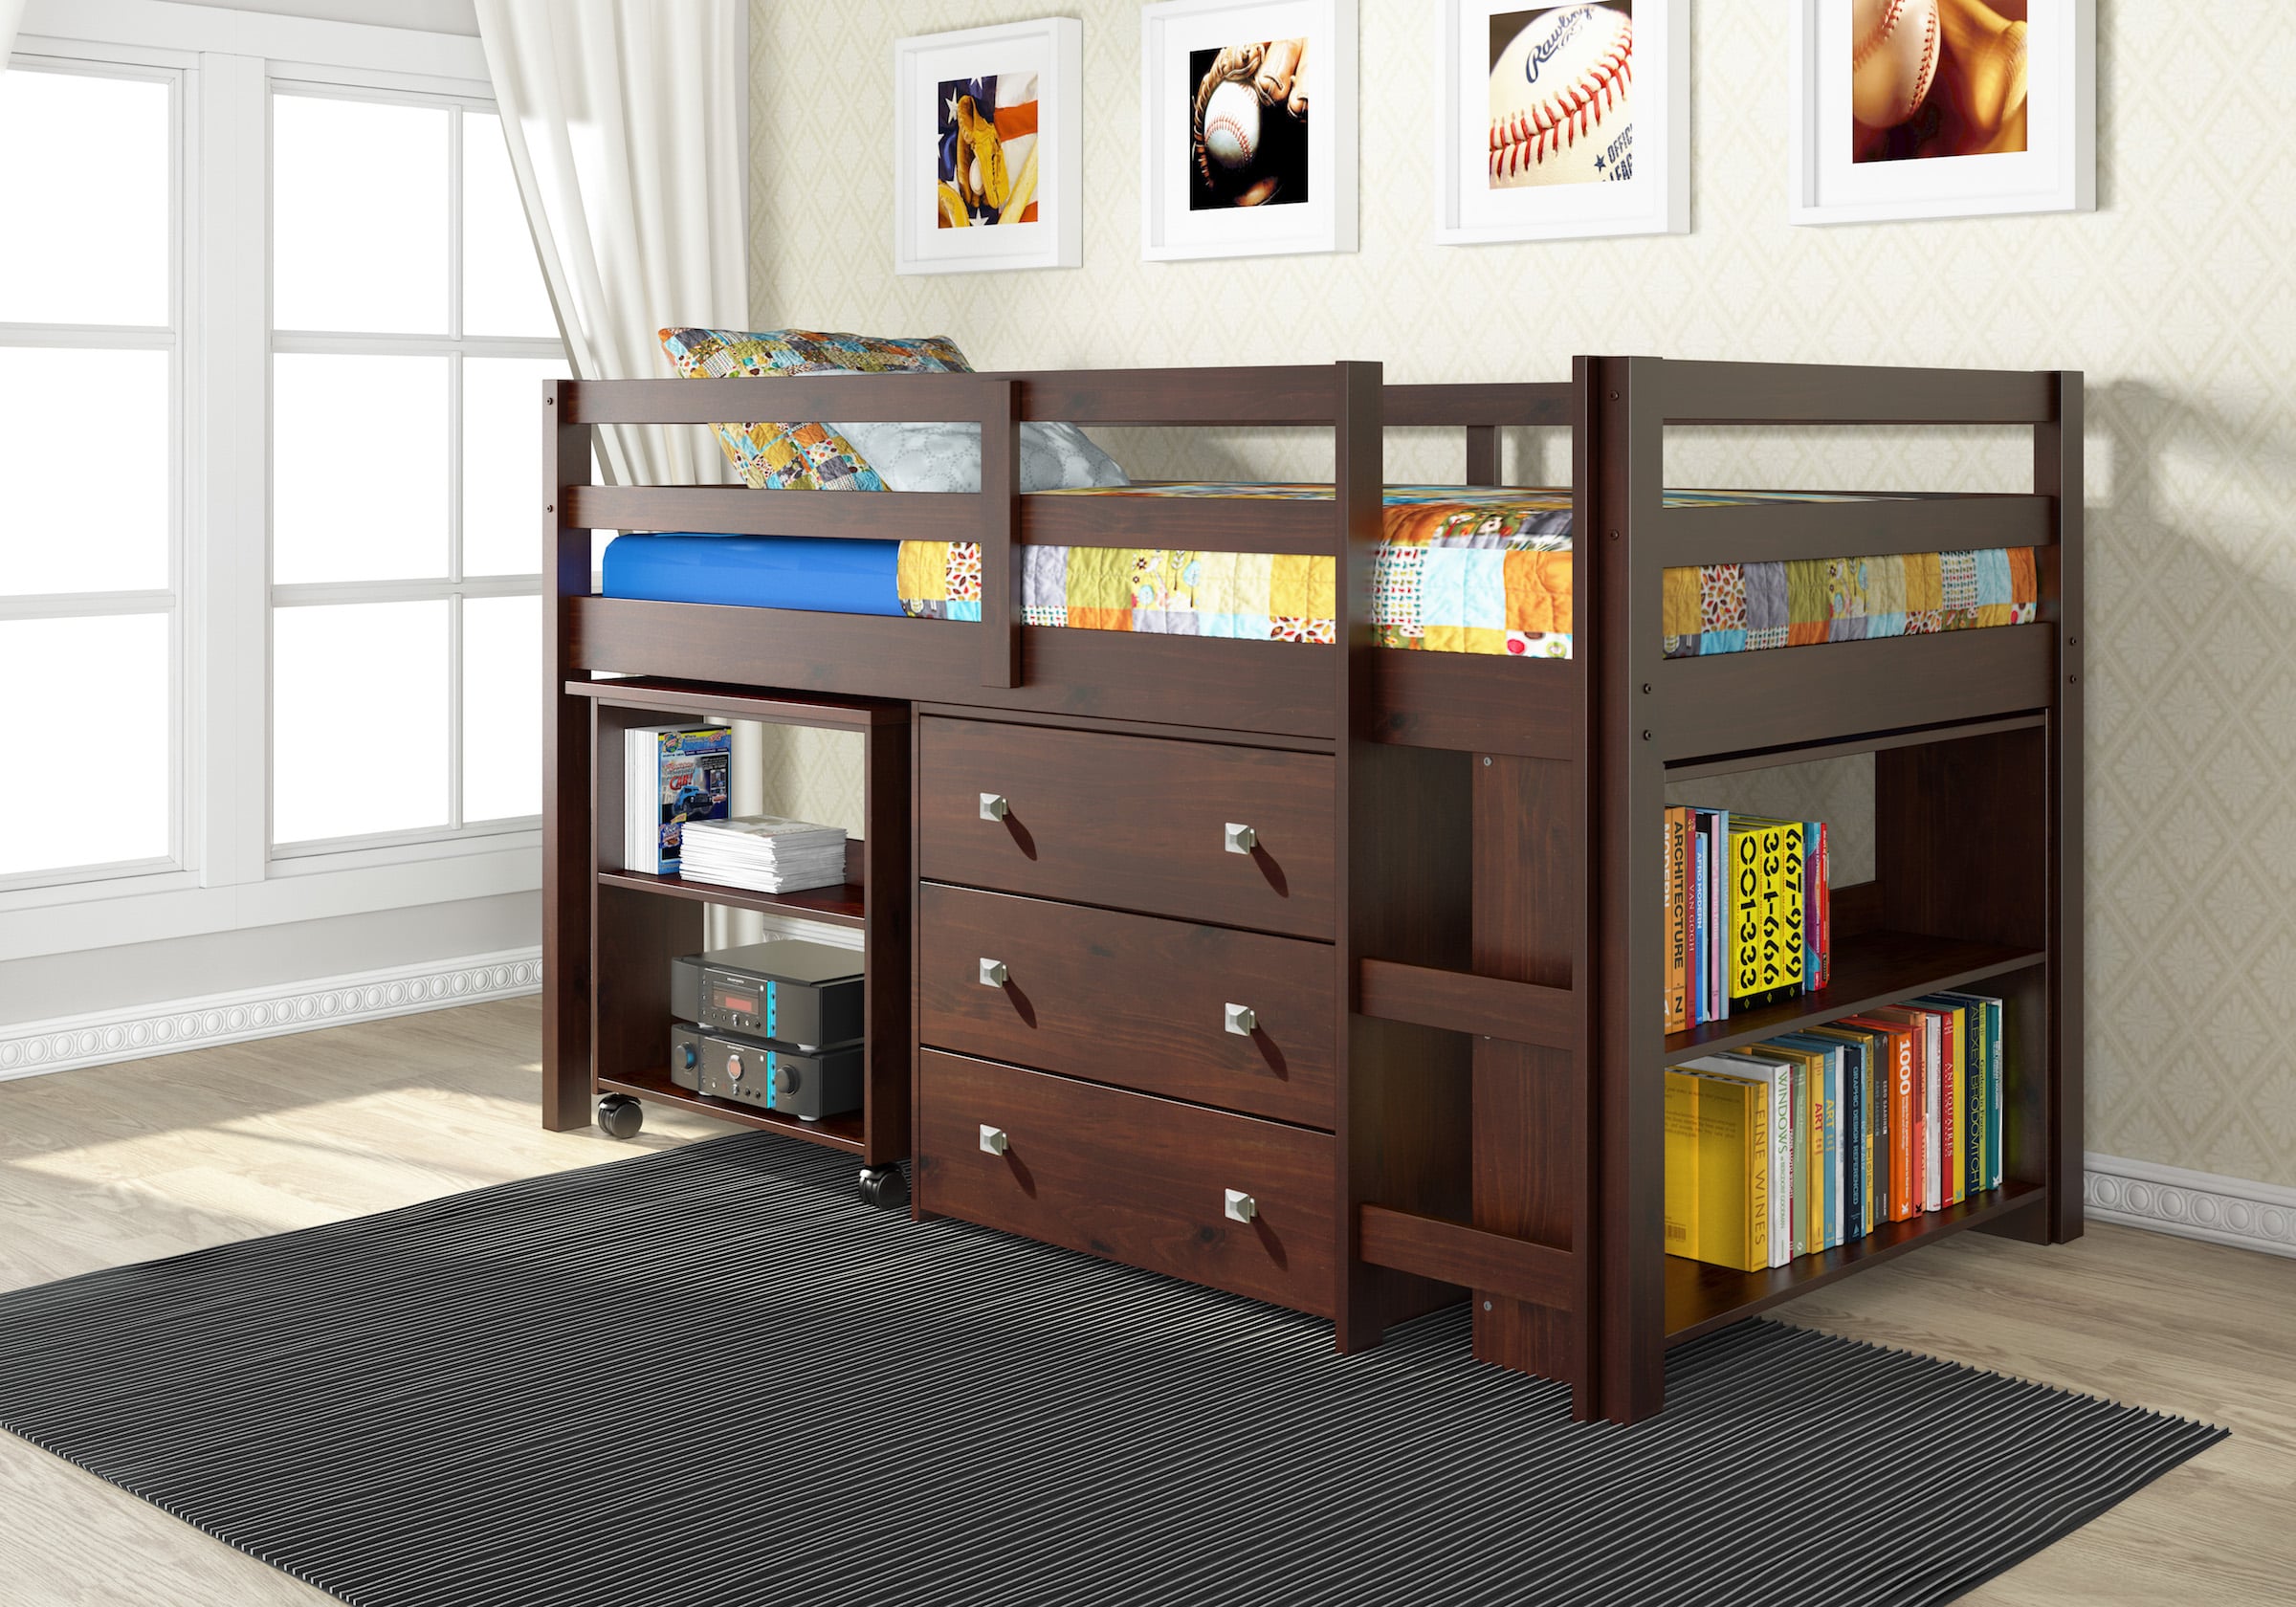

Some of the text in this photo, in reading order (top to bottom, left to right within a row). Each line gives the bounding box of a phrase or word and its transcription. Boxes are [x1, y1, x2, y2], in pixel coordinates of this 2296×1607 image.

[1674, 821, 1684, 970] ARCHITECTURE
[1740, 835, 1757, 989] 001-333
[1763, 832, 1779, 985] 334-666
[1785, 828, 1801, 979] 667-999
[1900, 1040, 1910, 1094] 1000
[1971, 1005, 1979, 1183] ALEXEY BRODOVITCH
[1755, 1109, 1766, 1161] FINE
[1777, 1070, 1788, 1155] WINDOWS
[1814, 1103, 1823, 1133] ART
[1825, 1099, 1835, 1129] ART
[1755, 1169, 1766, 1245] WINES
